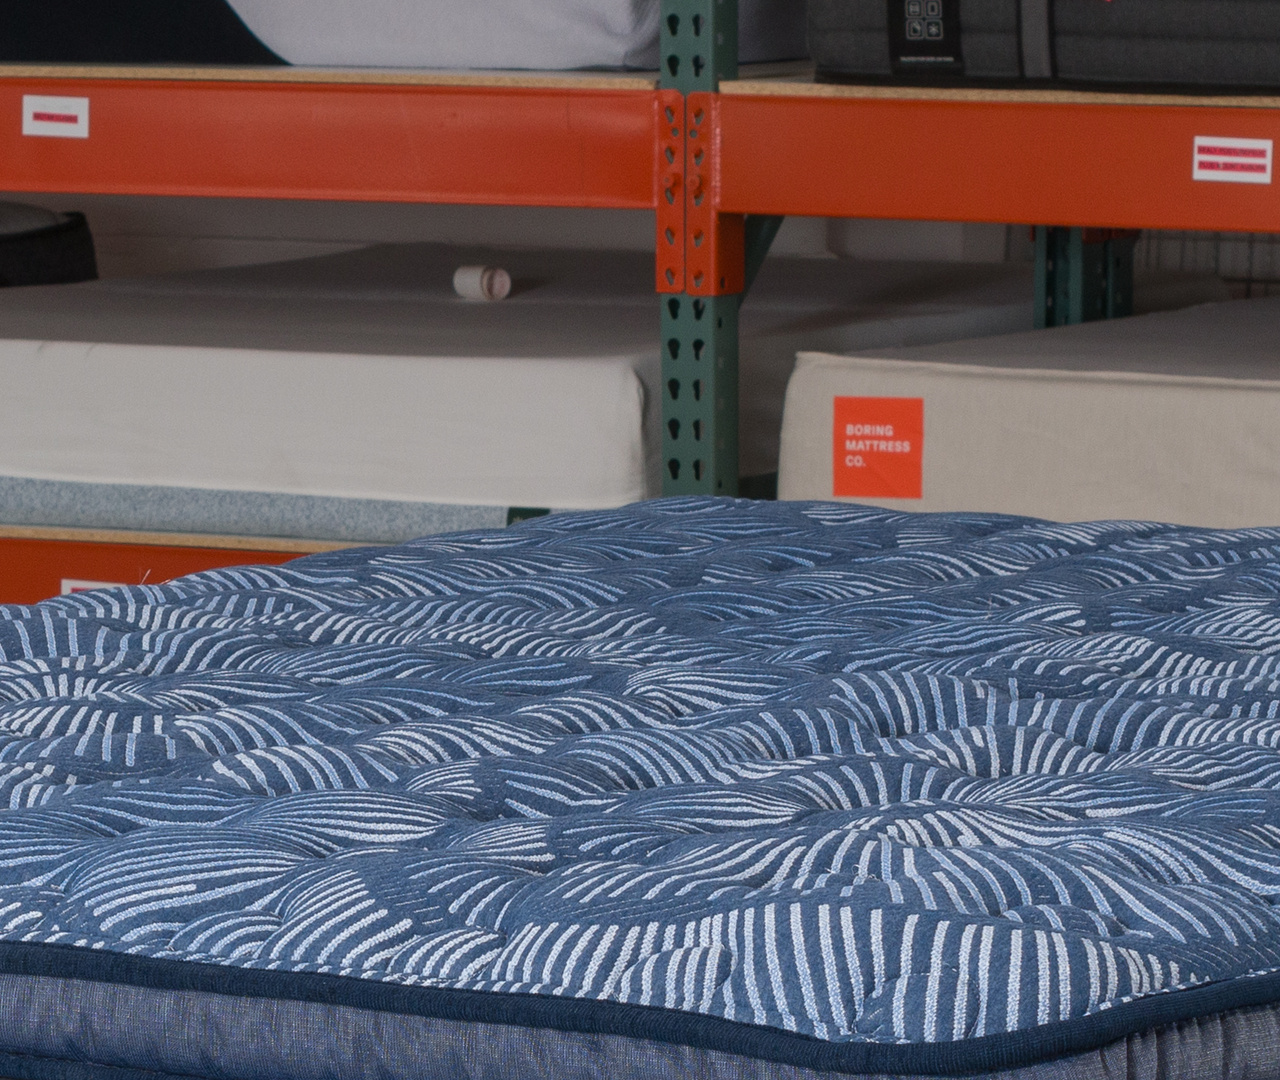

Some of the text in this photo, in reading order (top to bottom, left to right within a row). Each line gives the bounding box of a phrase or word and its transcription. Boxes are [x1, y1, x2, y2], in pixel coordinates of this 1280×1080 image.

[845, 424, 894, 437] BORING
[845, 439, 911, 453] MATTRESS
[845, 455, 867, 467] CO.
